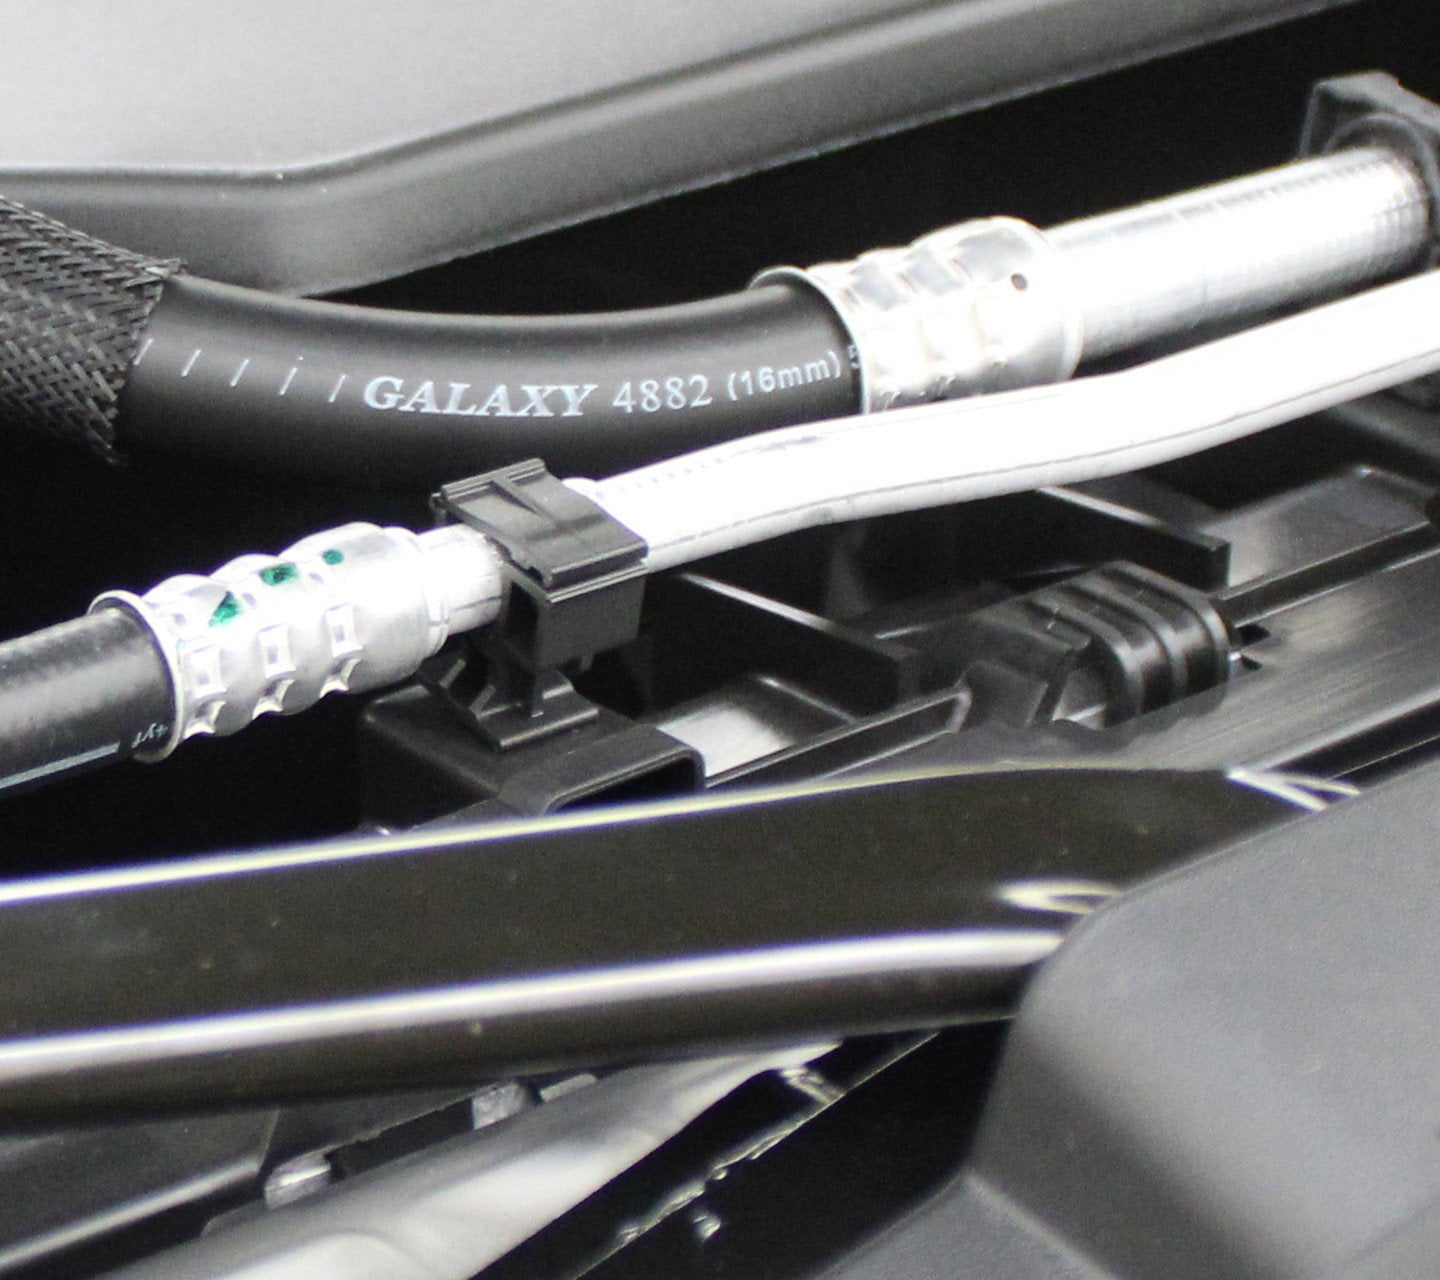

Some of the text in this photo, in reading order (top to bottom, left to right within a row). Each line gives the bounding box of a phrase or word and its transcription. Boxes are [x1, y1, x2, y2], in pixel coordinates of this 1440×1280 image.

[363, 375, 599, 418] GALAXY
[612, 373, 713, 414] 4882
[726, 349, 842, 402] (16mm)
